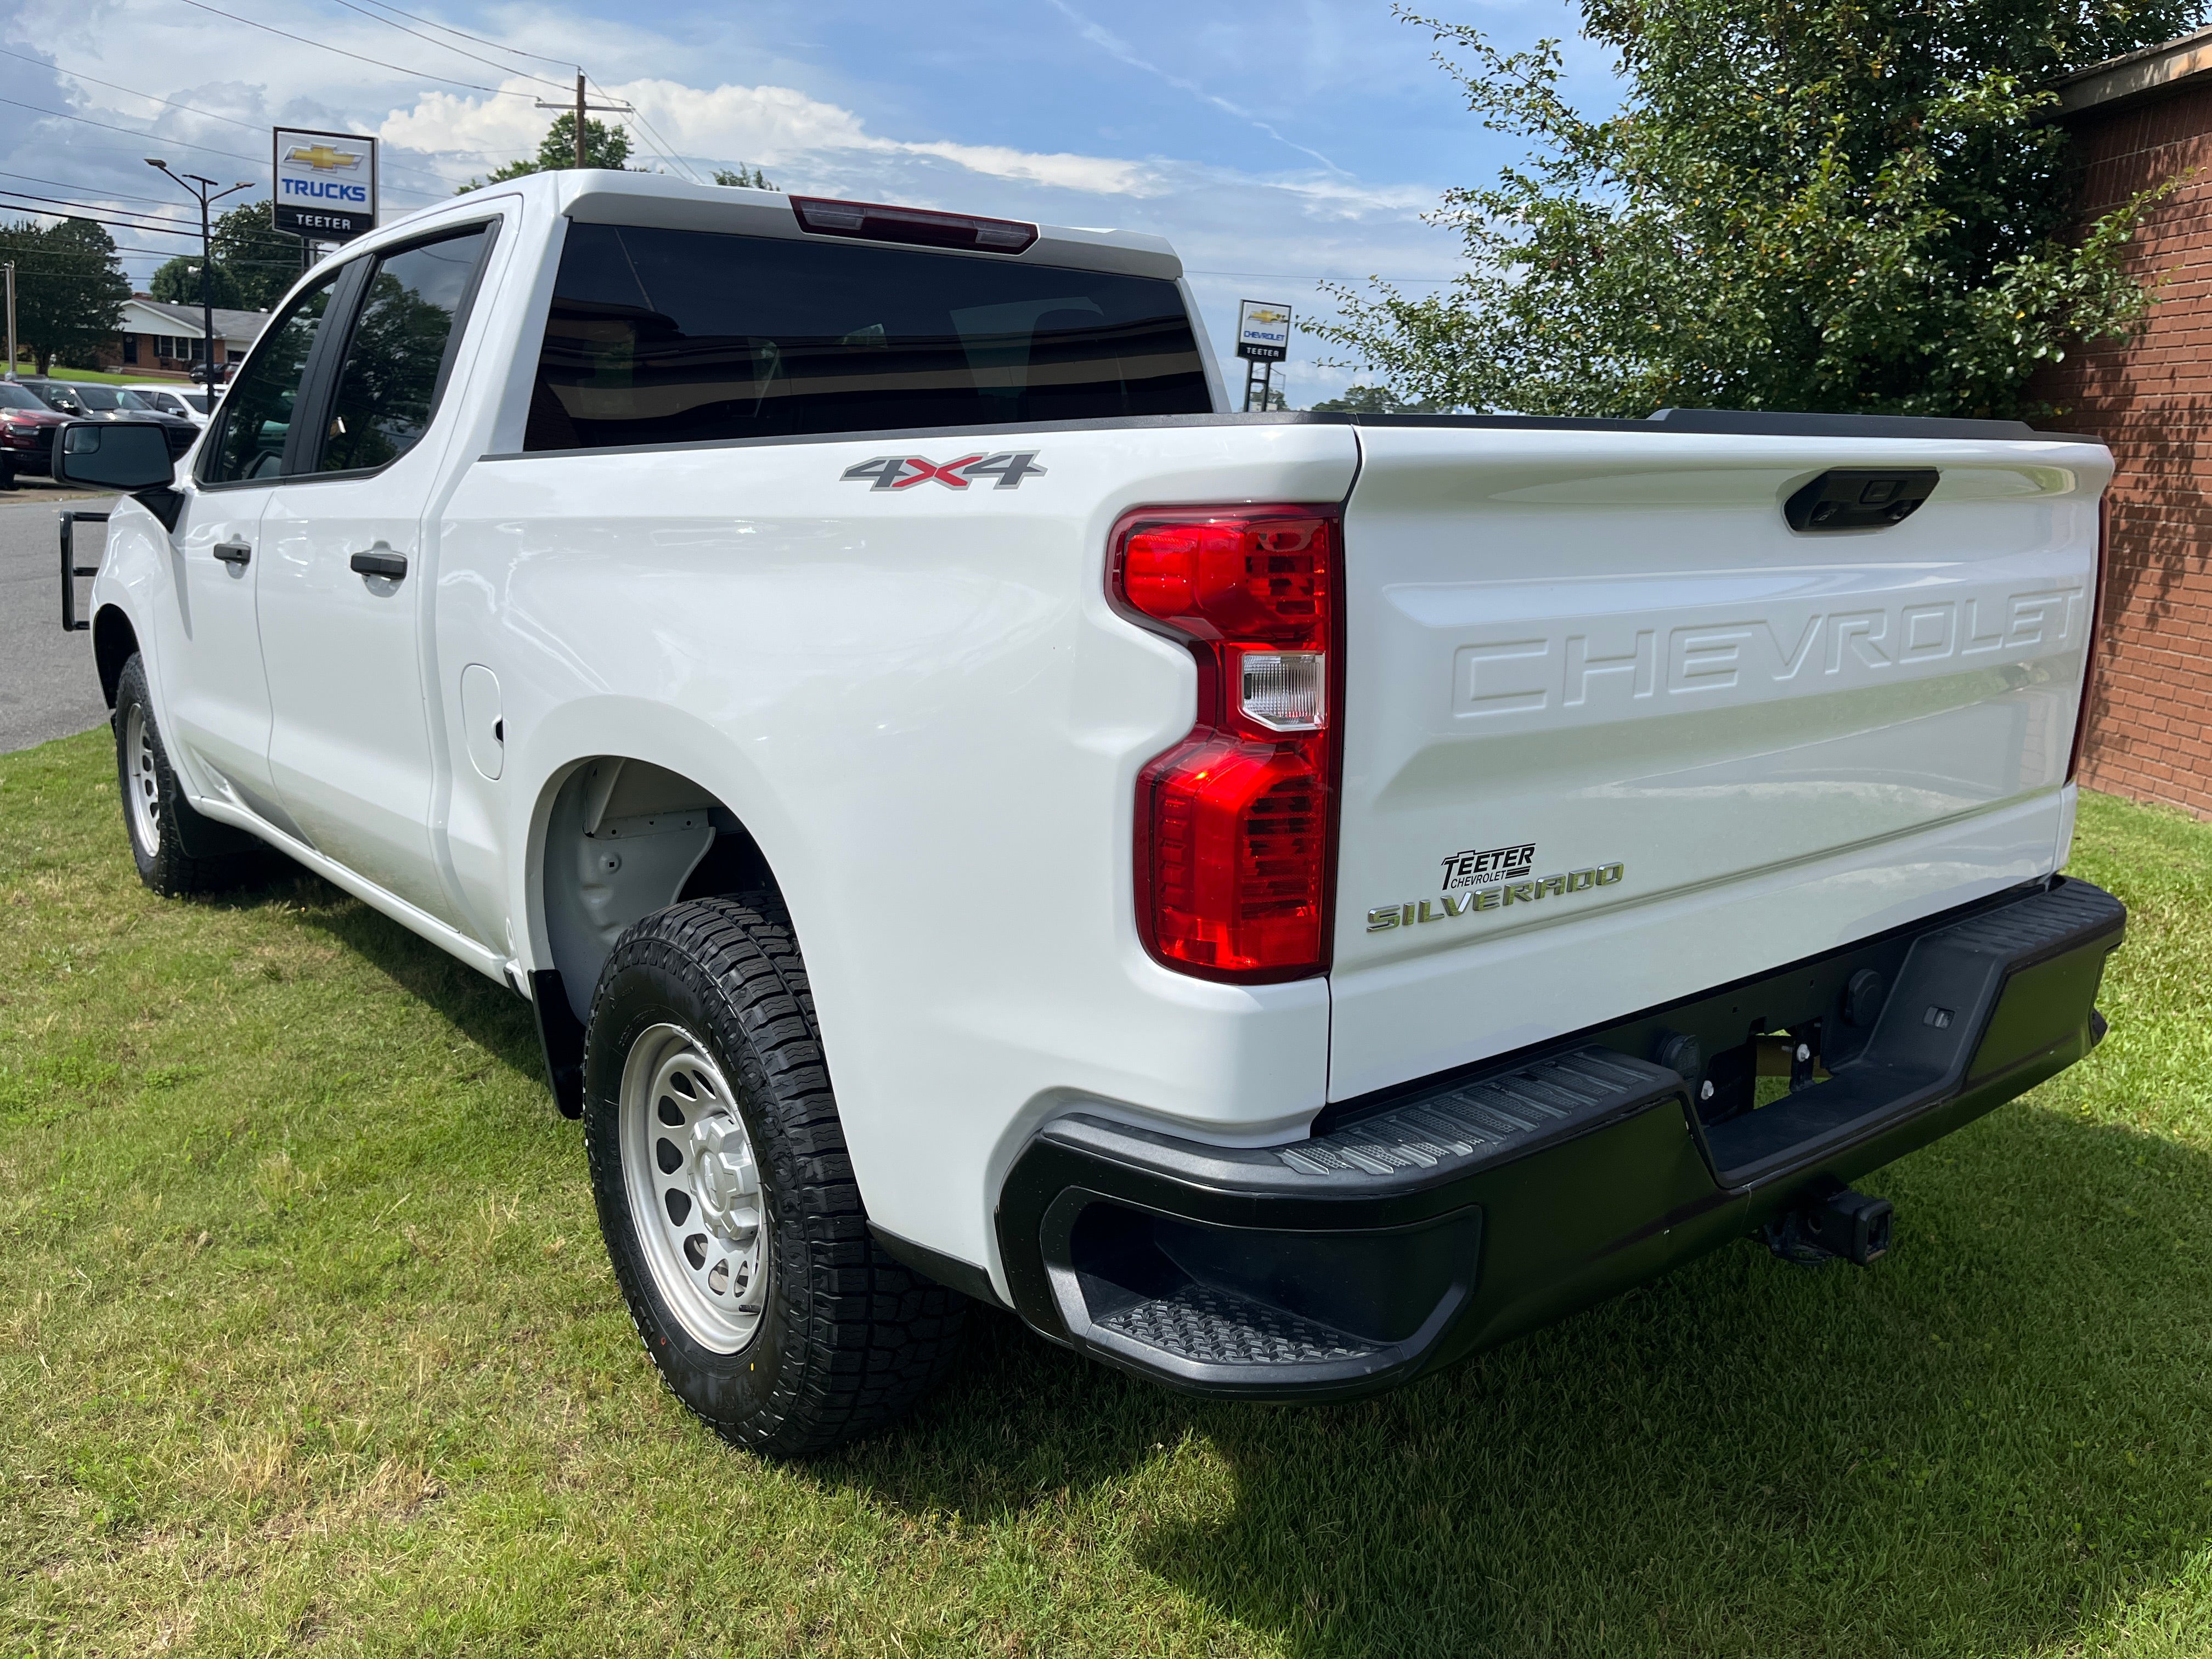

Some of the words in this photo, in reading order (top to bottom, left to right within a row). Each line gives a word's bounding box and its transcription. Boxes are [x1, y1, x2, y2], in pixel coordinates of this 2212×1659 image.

[281, 178, 366, 202] TRUCKS
[296, 214, 351, 230] TEETER
[1244, 331, 1284, 341] CHEVROLET
[1246, 347, 1279, 357] TEETER
[1452, 586, 2083, 719] CHEVROLET
[1442, 847, 1536, 890] TEETER
[1451, 870, 1506, 889] CHEVROLET
[1367, 861, 1624, 933] SILVERADO
